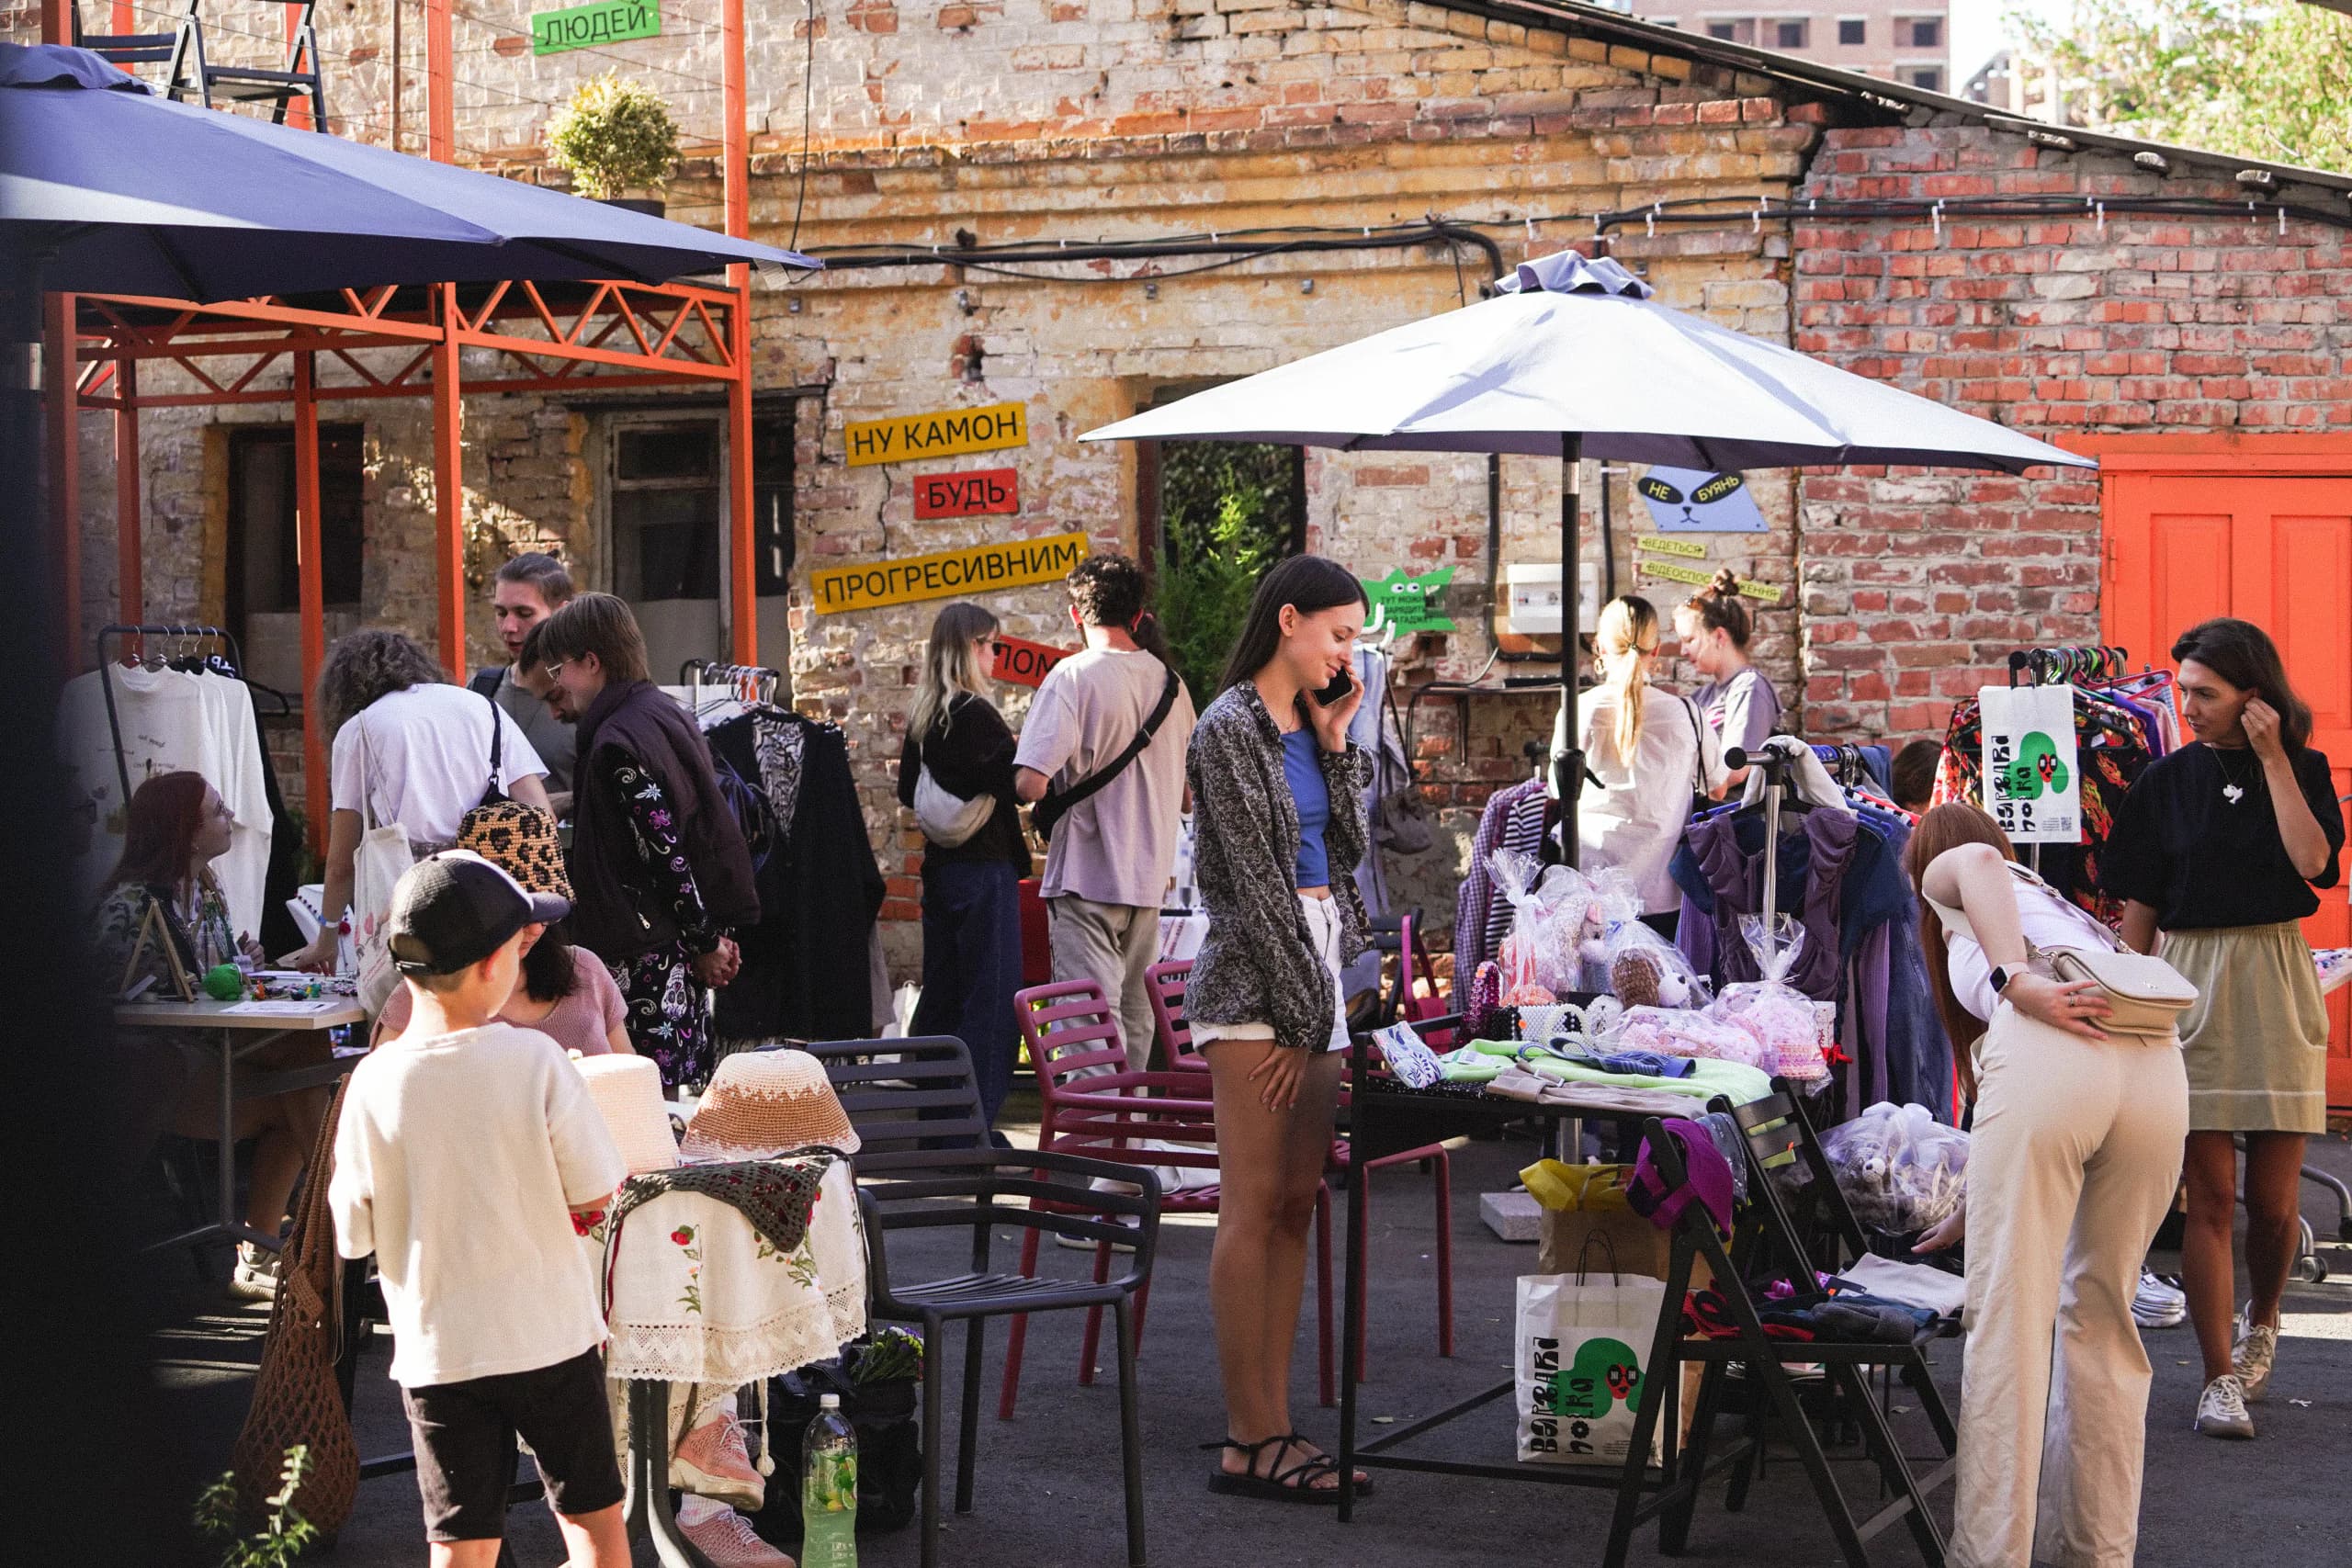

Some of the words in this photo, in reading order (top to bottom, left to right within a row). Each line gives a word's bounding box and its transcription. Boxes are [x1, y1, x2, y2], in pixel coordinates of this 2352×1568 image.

[546, 0, 647, 45] ЛЮДЕЙ
[854, 426, 893, 456] НУ
[904, 412, 1018, 450] КАМОН
[928, 479, 1005, 510] БУДЬ
[1648, 481, 1671, 501] НЕ
[1698, 476, 1740, 502] БУЯНЬ
[1645, 537, 1701, 553] ВЕДЕТЬСЯ
[824, 542, 1079, 604] ПРОГРЕСИВНИМ
